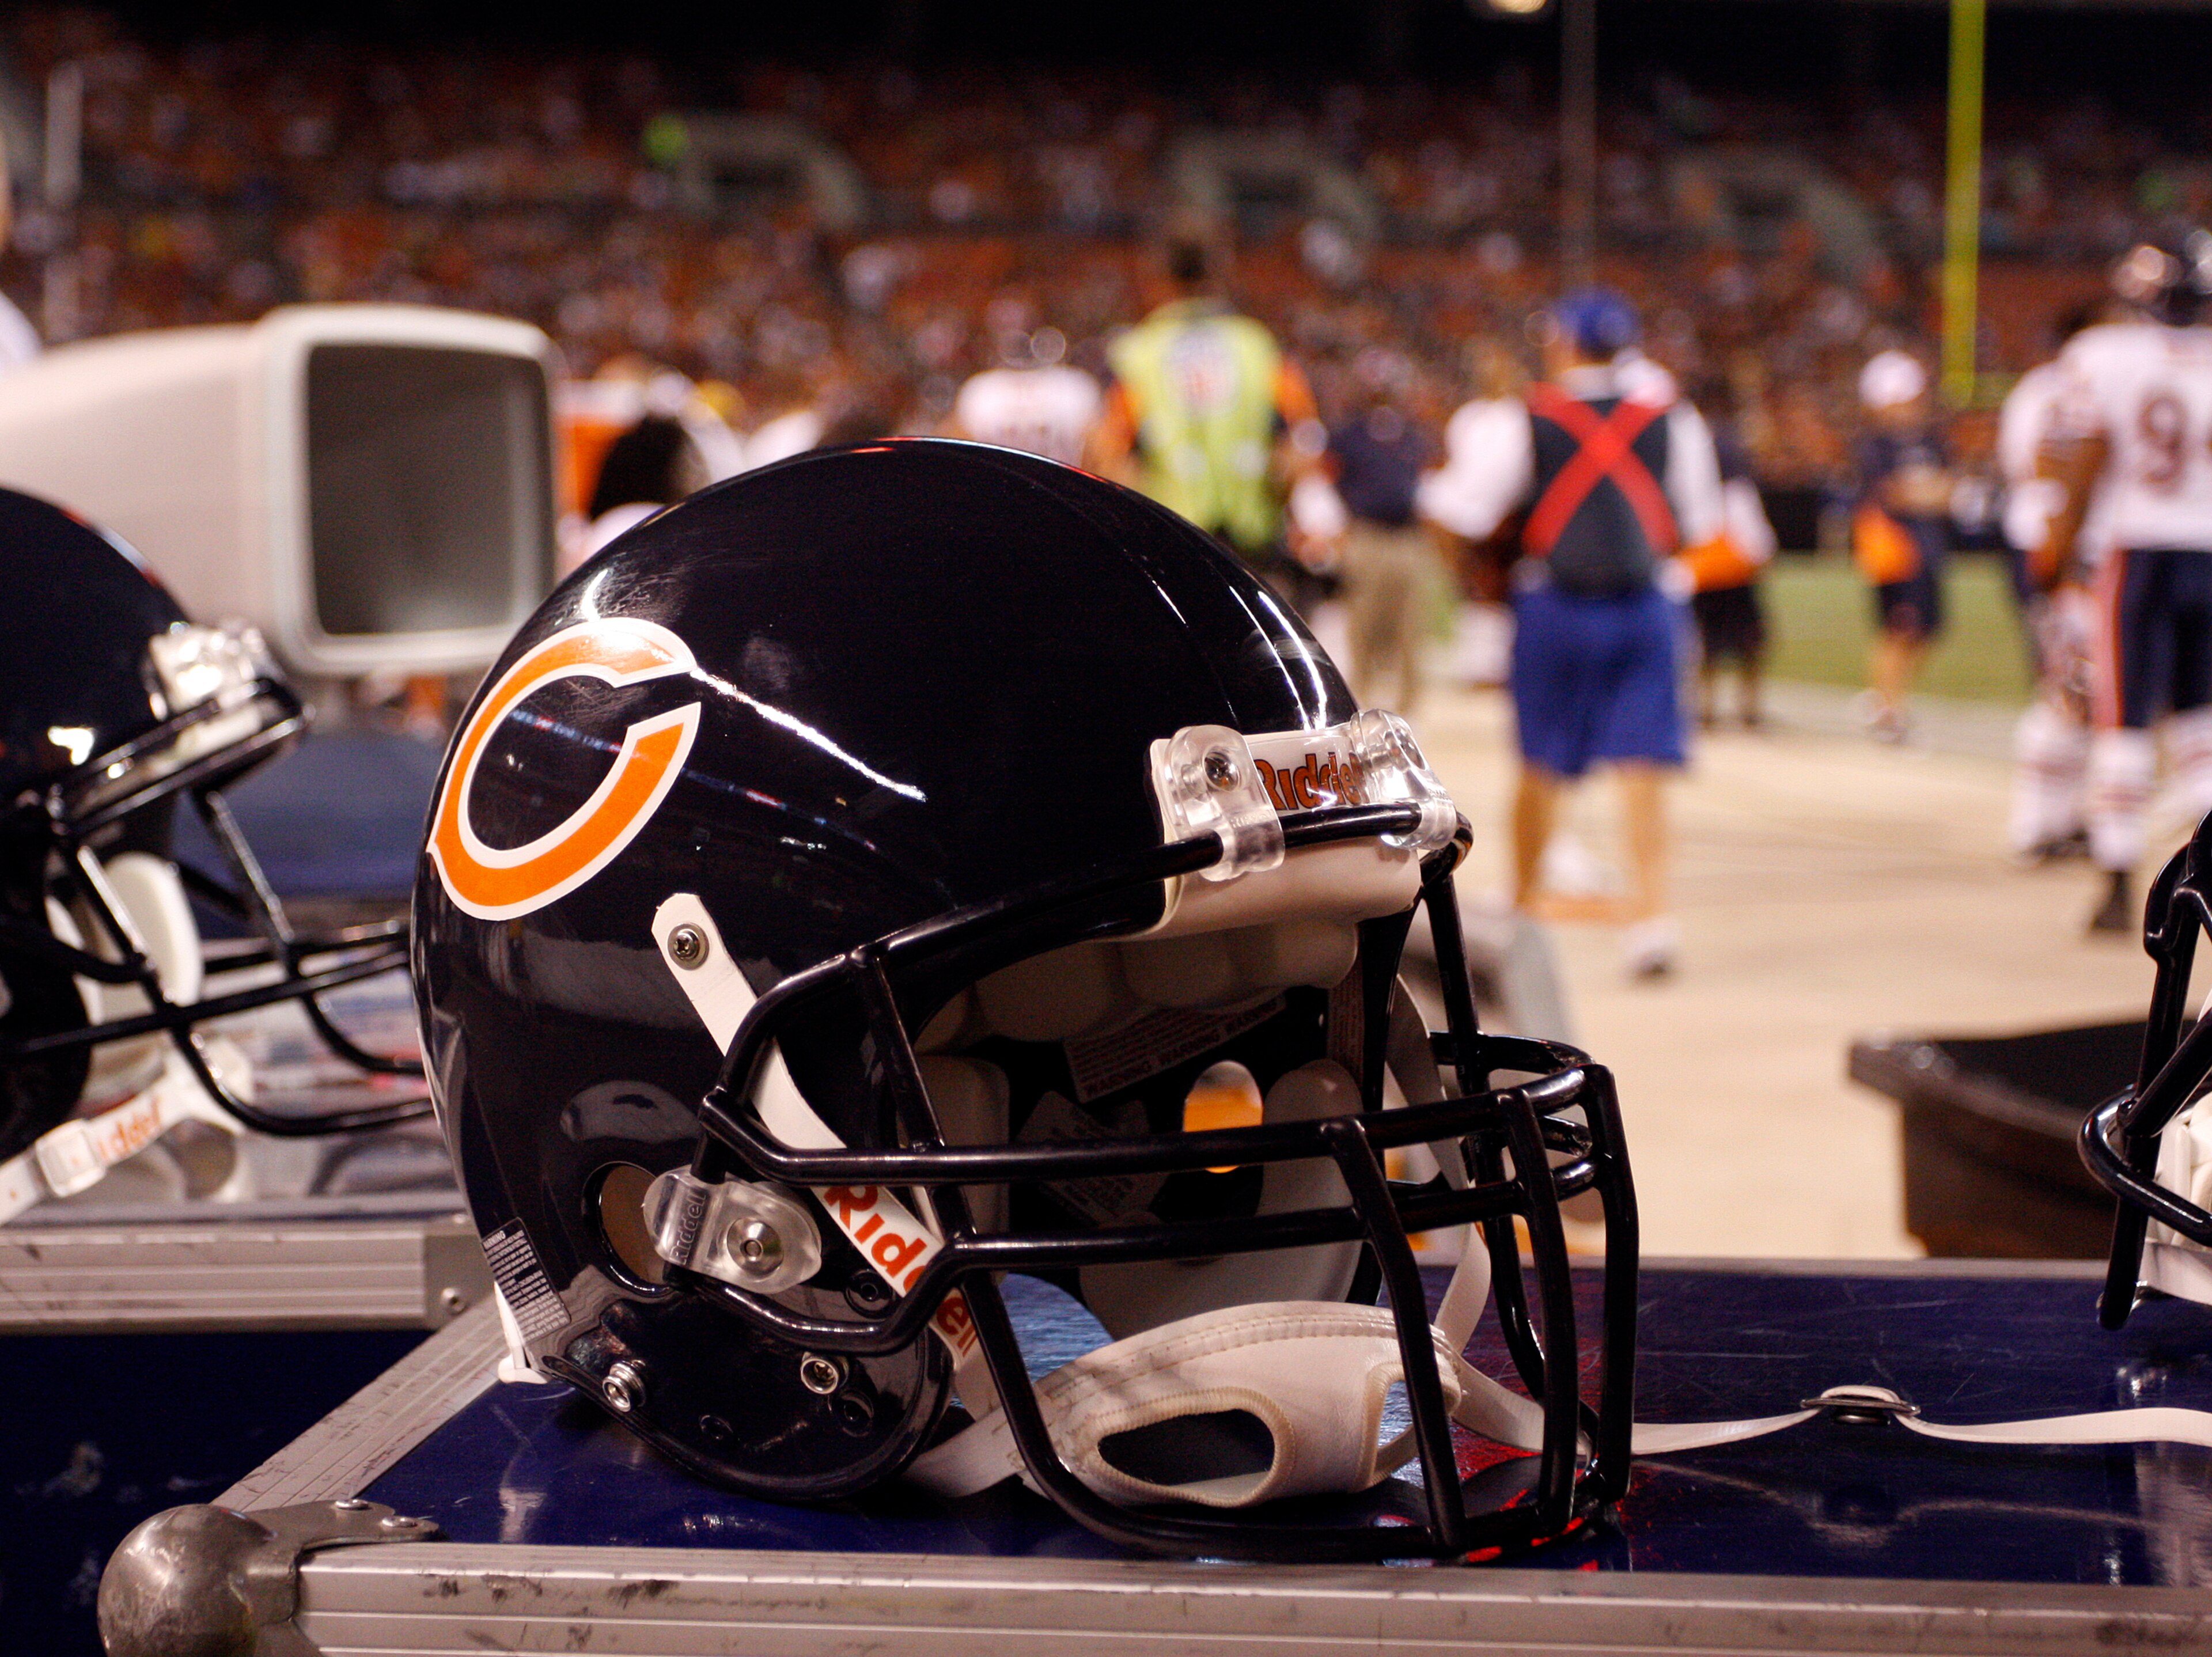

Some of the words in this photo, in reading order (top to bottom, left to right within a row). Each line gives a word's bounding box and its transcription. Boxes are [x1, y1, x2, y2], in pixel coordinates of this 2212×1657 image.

[426, 617, 701, 921] C
[1253, 752, 1370, 810] Riddel
[669, 1186, 710, 1265] Riddell
